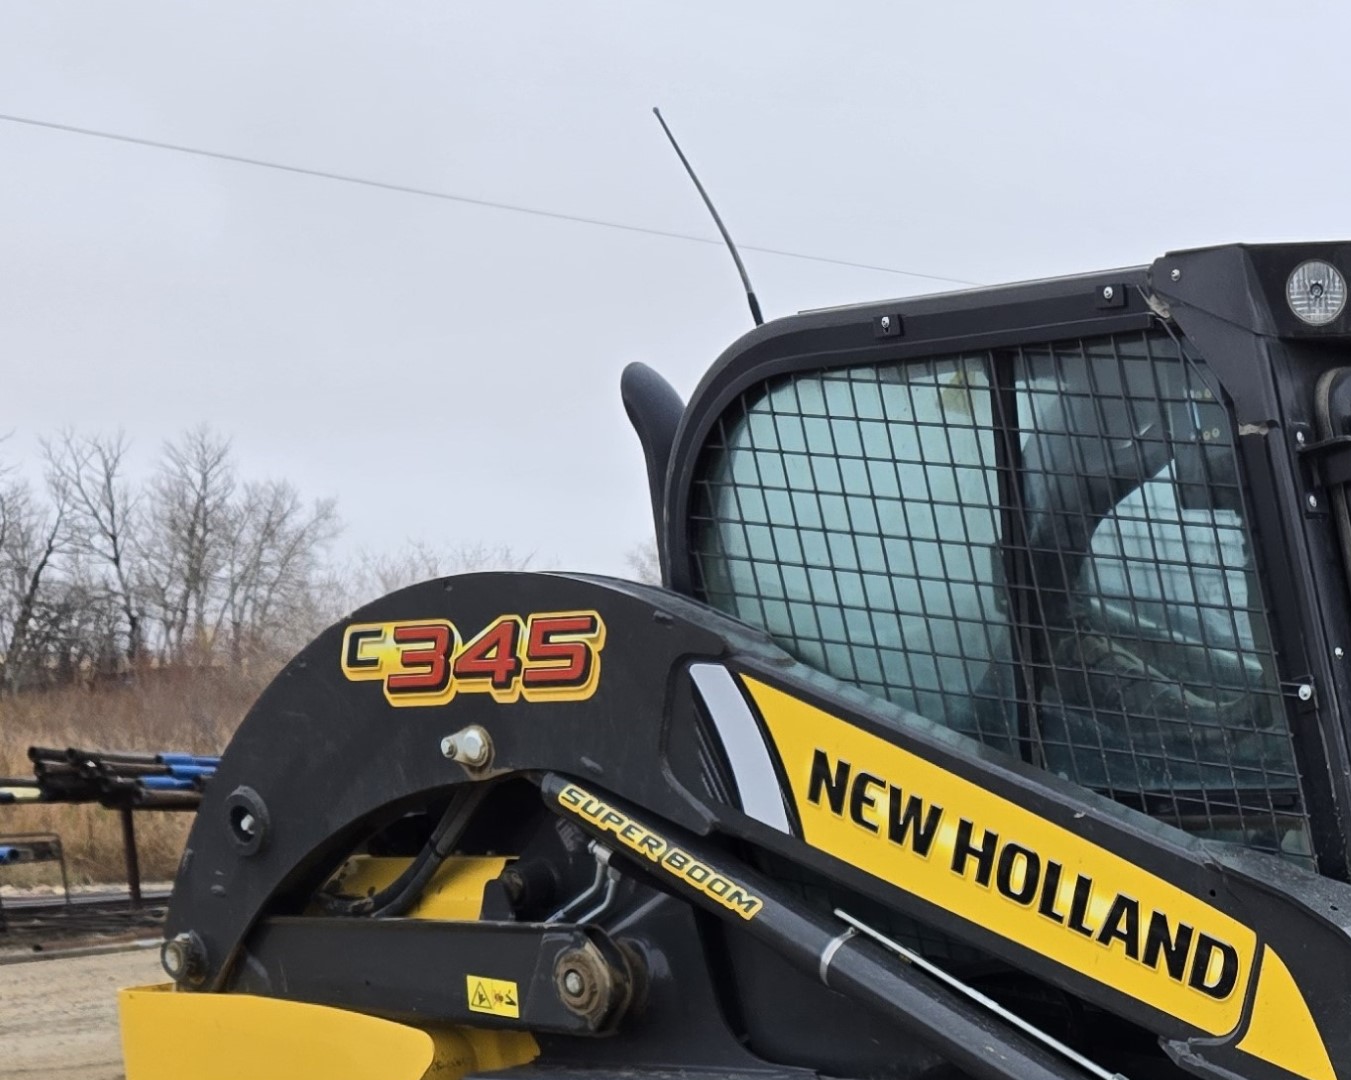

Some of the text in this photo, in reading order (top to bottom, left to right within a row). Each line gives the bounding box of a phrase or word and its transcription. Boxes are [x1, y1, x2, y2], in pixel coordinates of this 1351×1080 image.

[560, 786, 760, 916] SUPER BOOM
[807, 748, 1240, 1001] NEW HOLLAND
